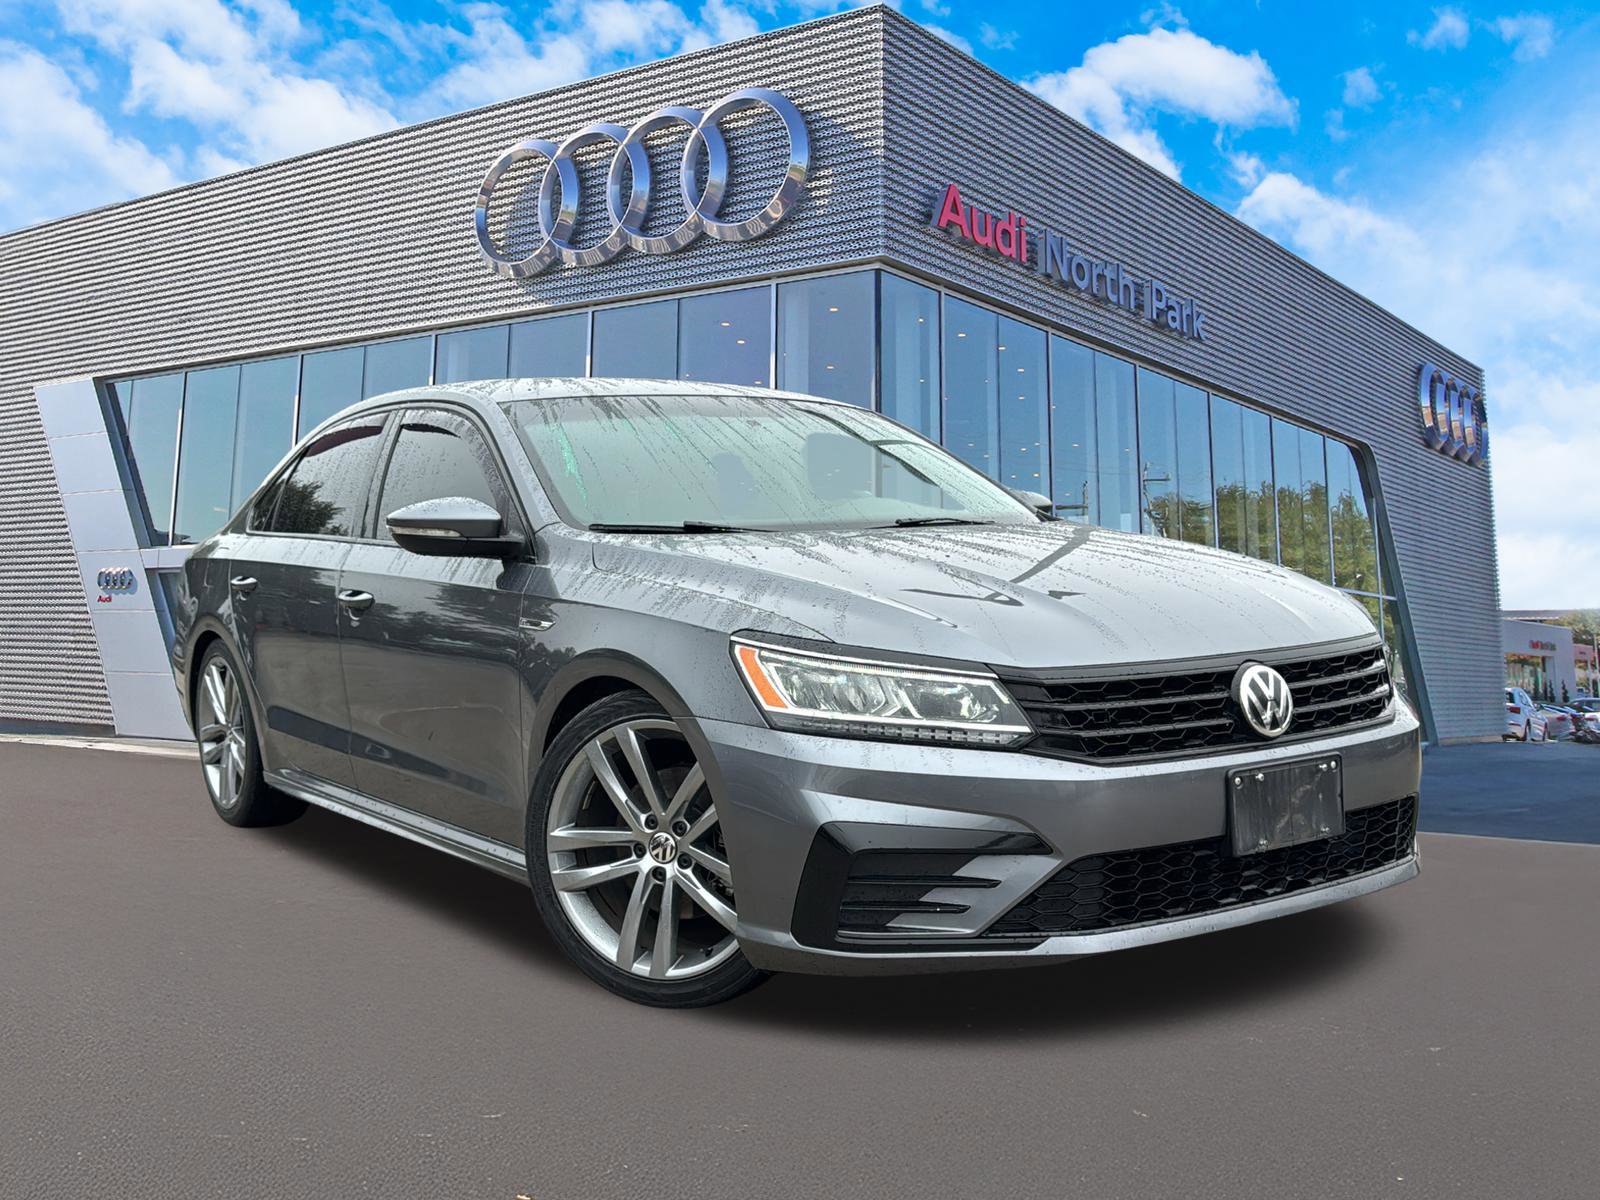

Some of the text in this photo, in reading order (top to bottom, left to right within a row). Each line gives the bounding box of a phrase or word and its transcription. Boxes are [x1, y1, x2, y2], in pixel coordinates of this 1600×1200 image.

[932, 183, 1207, 340] Audi North Park
